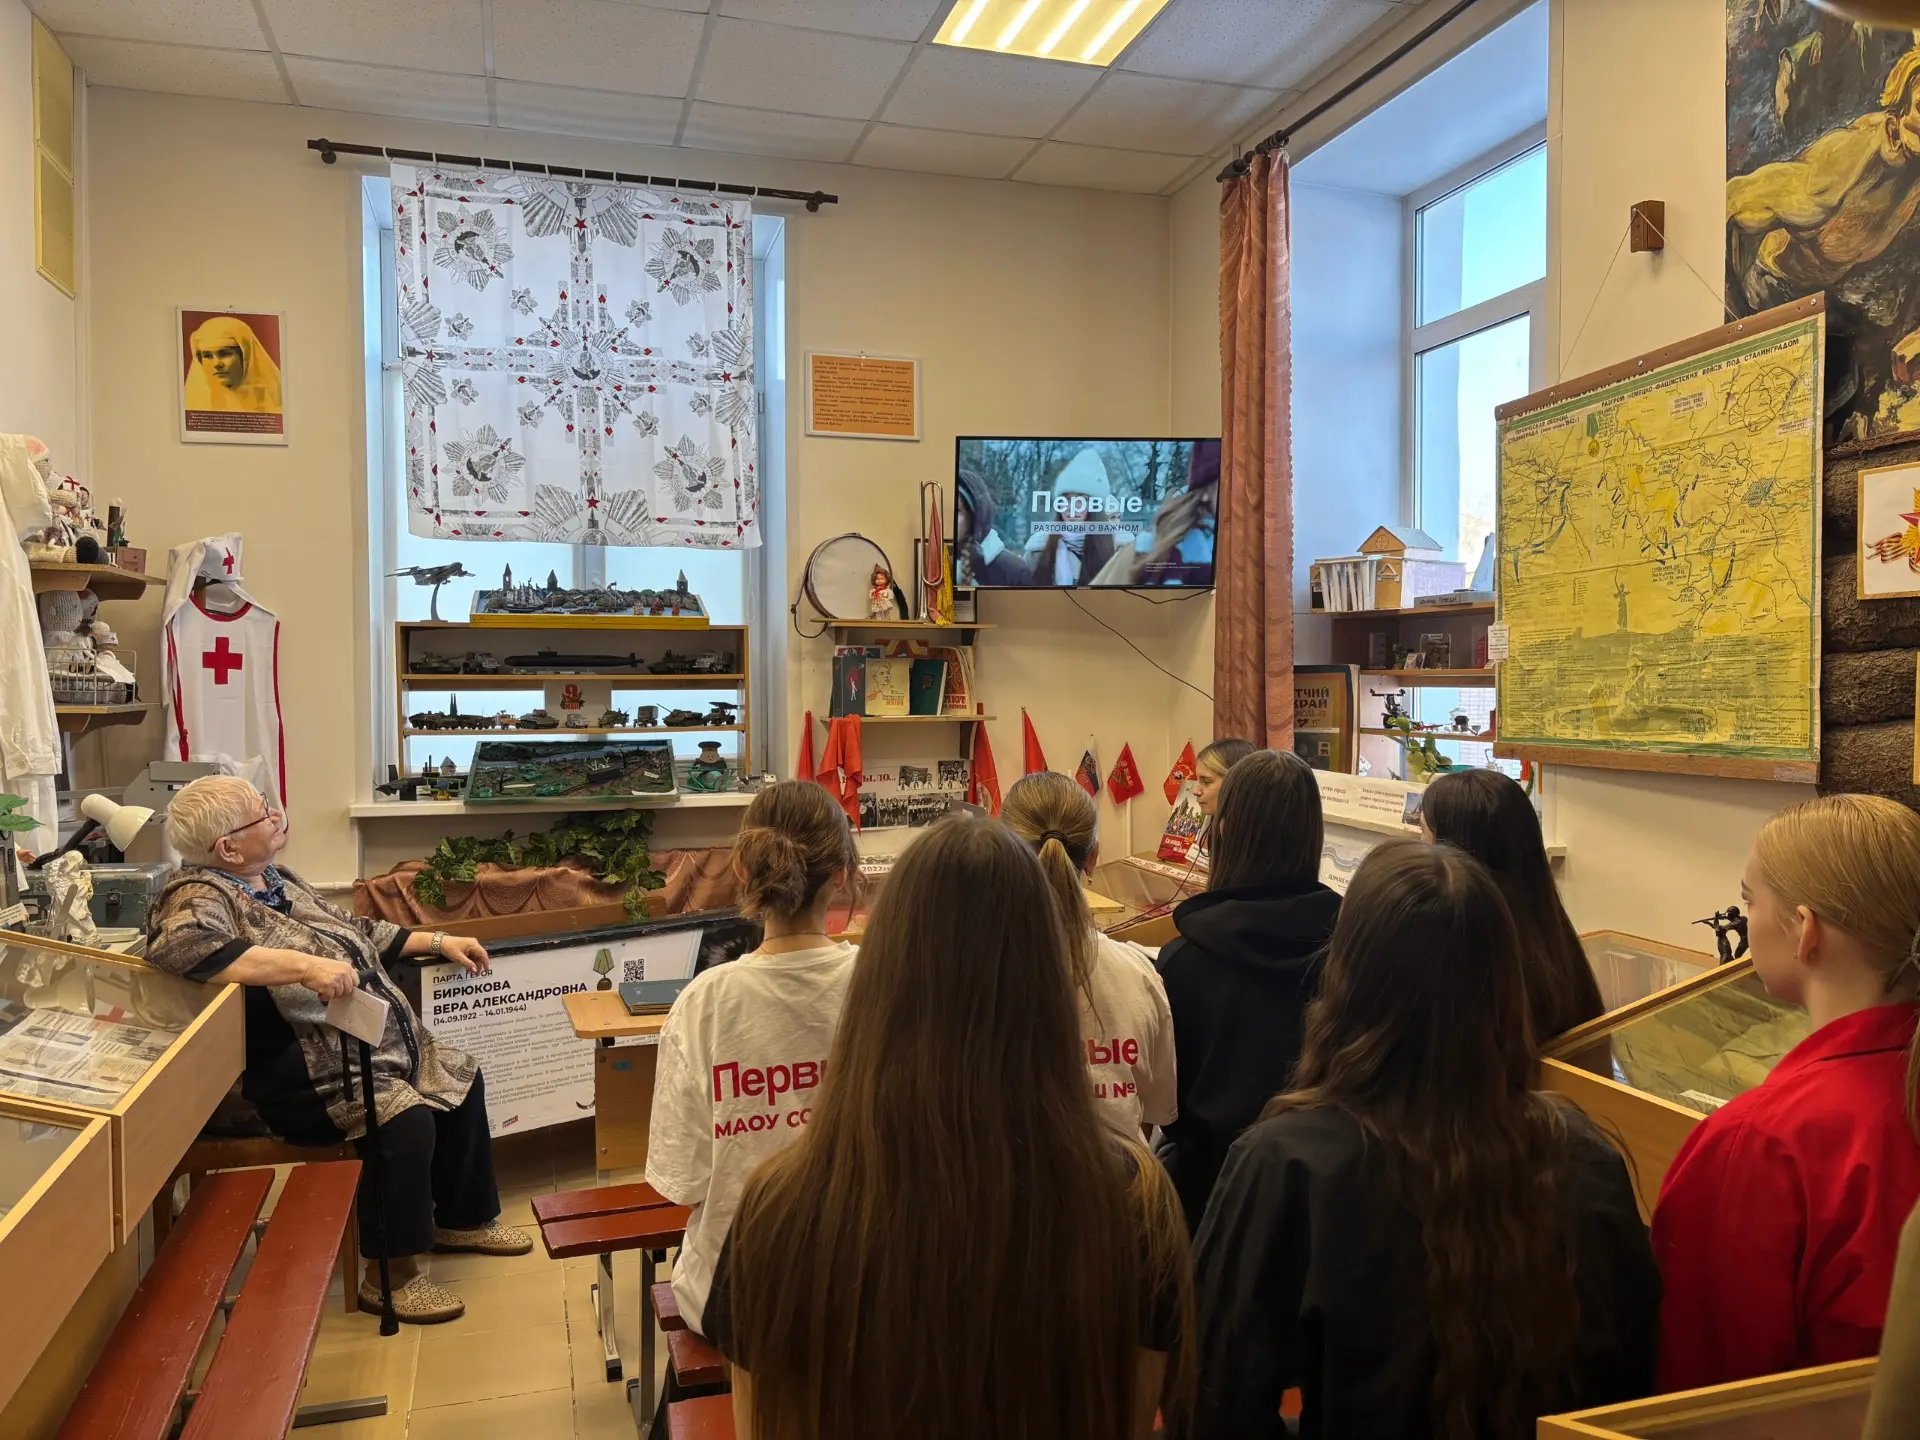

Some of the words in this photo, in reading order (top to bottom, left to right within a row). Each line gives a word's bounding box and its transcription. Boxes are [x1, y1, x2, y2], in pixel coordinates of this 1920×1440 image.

[1744, 338, 1800, 361] СТАЛИНГРАДОМ
[1032, 490, 1143, 517] Первые
[1034, 524, 1086, 532] РАЗГОВОРЫ
[1089, 524, 1096, 532] О
[1098, 524, 1140, 532] ВАЖНОМ
[564, 684, 578, 699] 9
[1295, 686, 1330, 698] ТЧИЙ
[433, 973, 463, 984] ПАРТА
[433, 980, 511, 1000] БИРЮКОВА
[433, 1001, 469, 1015] ВЕРА
[472, 983, 588, 1009] АЛЕКСАНДРОВНА
[433, 1013, 478, 1026] (14.09.1922
[485, 1004, 527, 1017] 14.01.1944)
[715, 1113, 780, 1139] МАОУ
